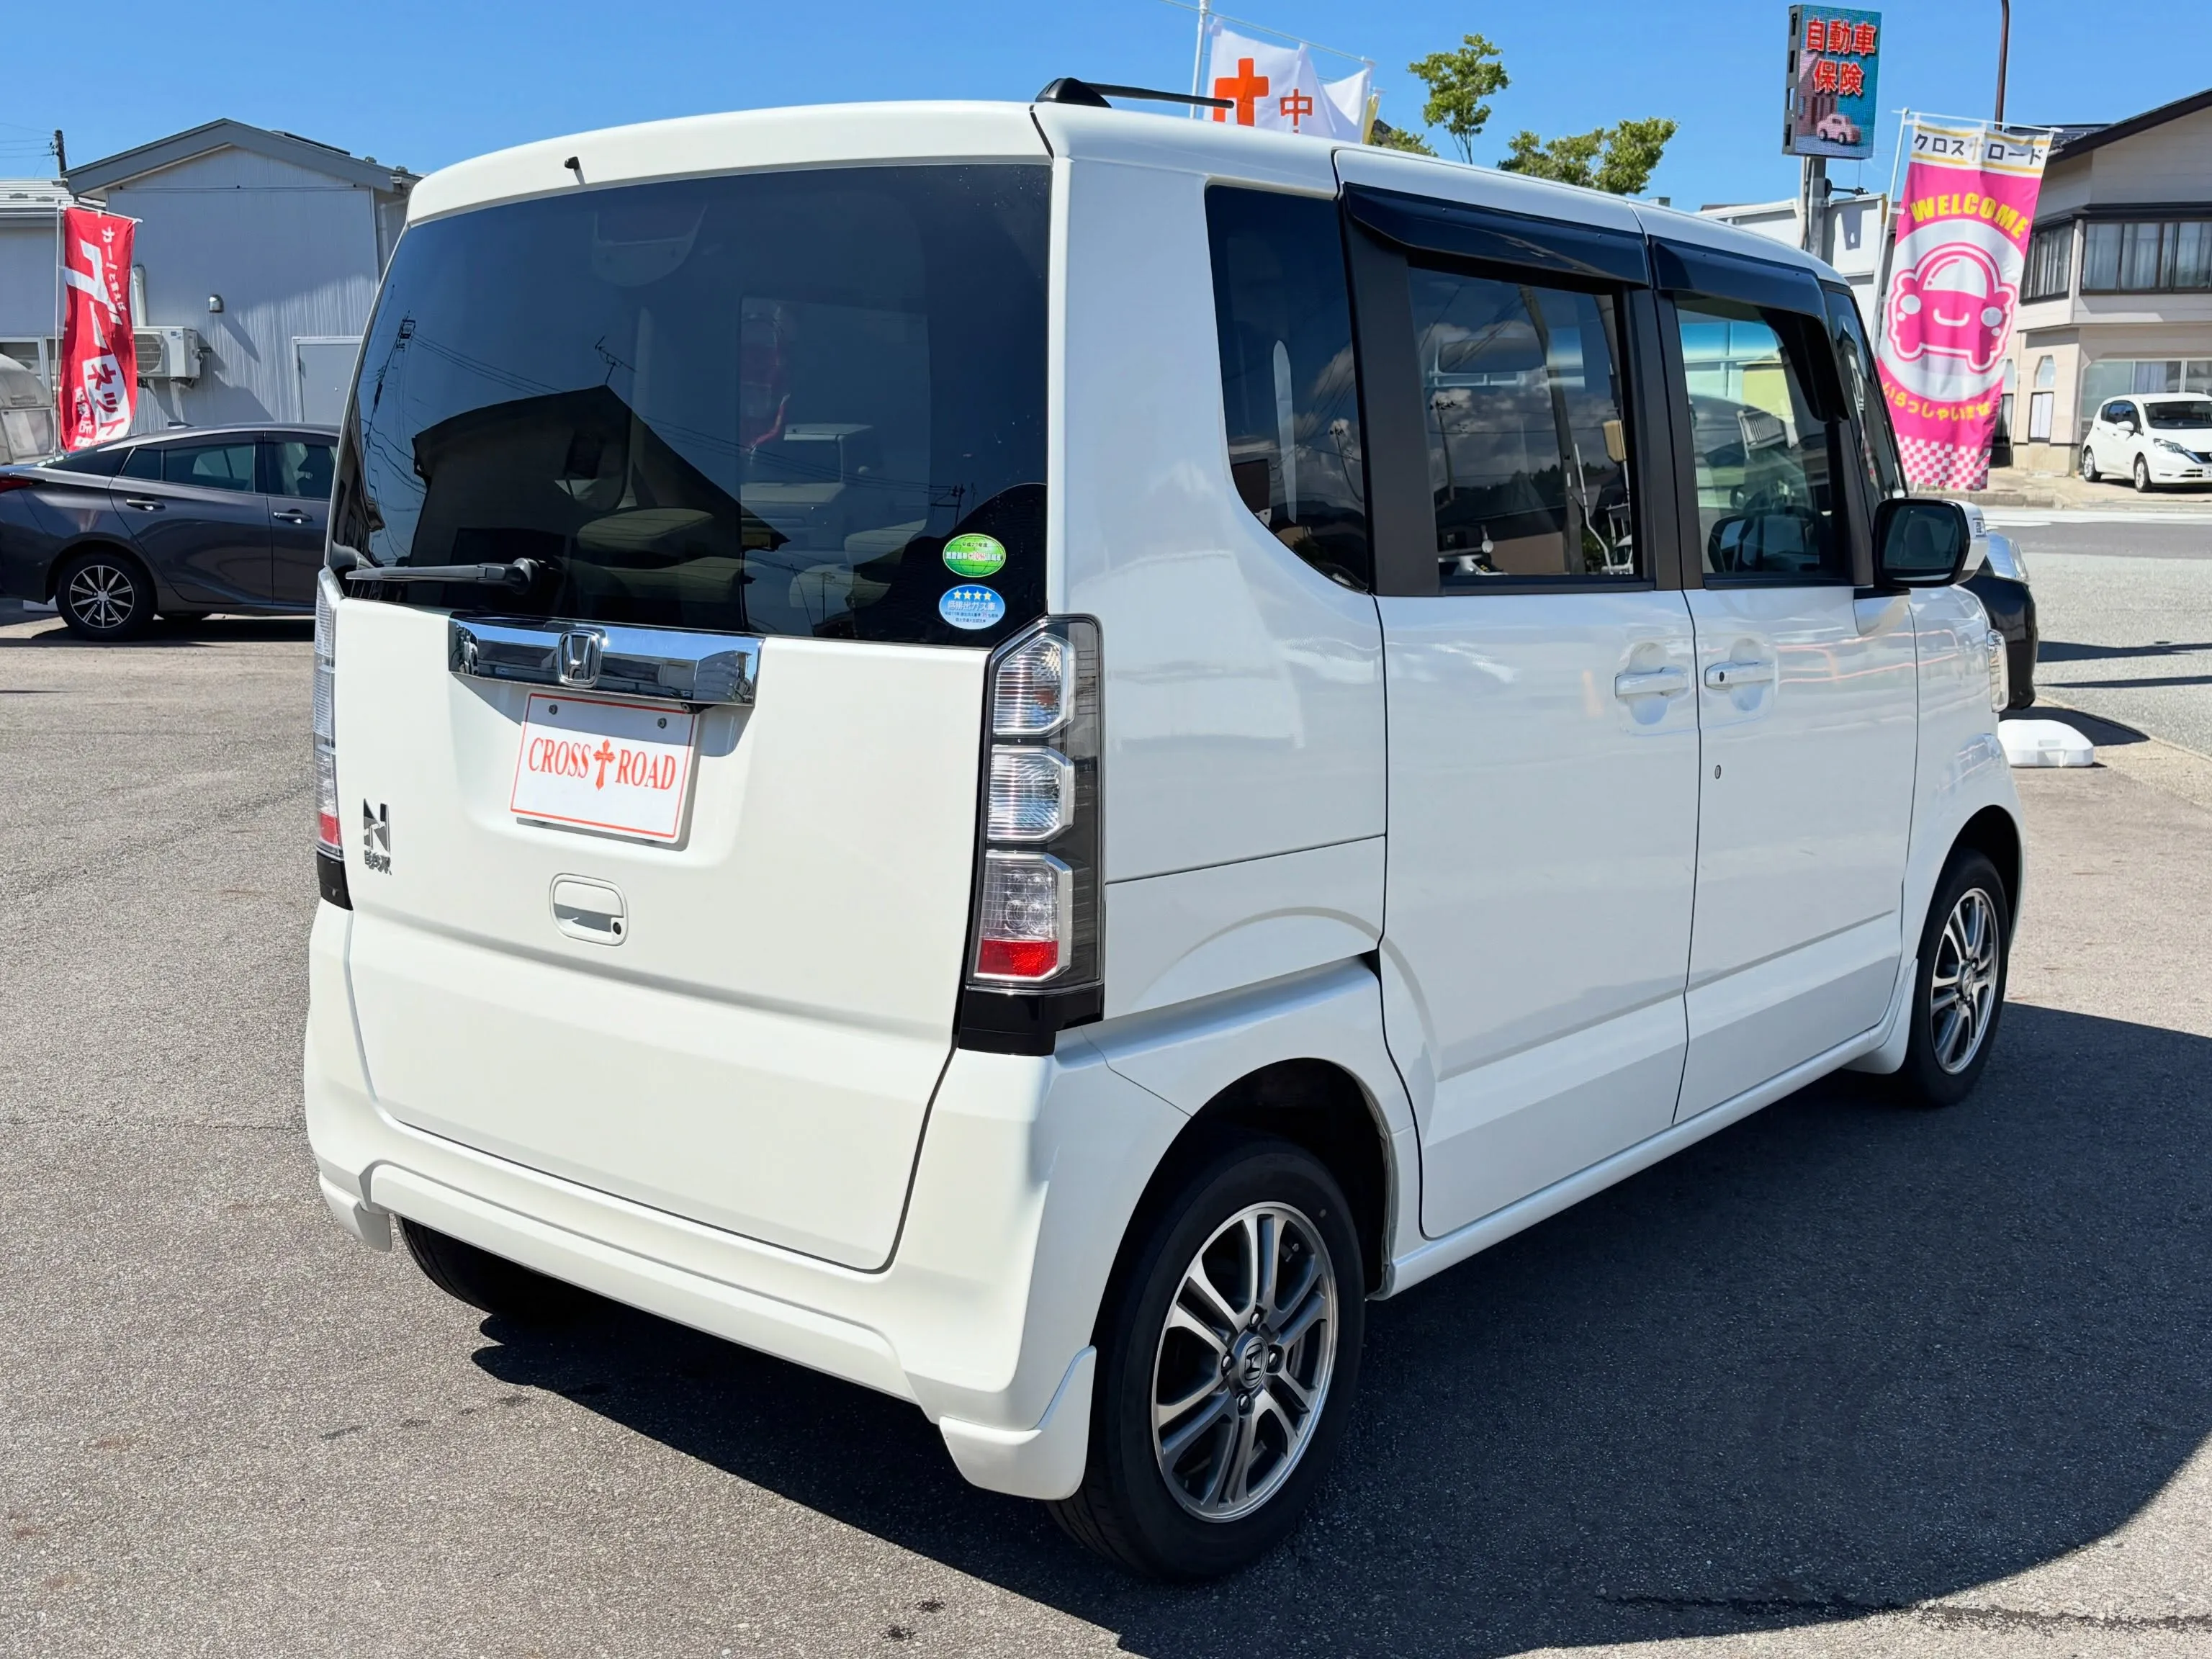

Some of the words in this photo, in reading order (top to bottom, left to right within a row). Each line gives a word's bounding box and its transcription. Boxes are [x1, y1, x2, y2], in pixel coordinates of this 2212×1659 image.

[1806, 17, 1876, 55] 自動車
[1813, 59, 1864, 96] 保険
[1910, 192, 2029, 239] WELCOME
[528, 737, 591, 778] CROSS
[615, 749, 676, 791] ROAD
